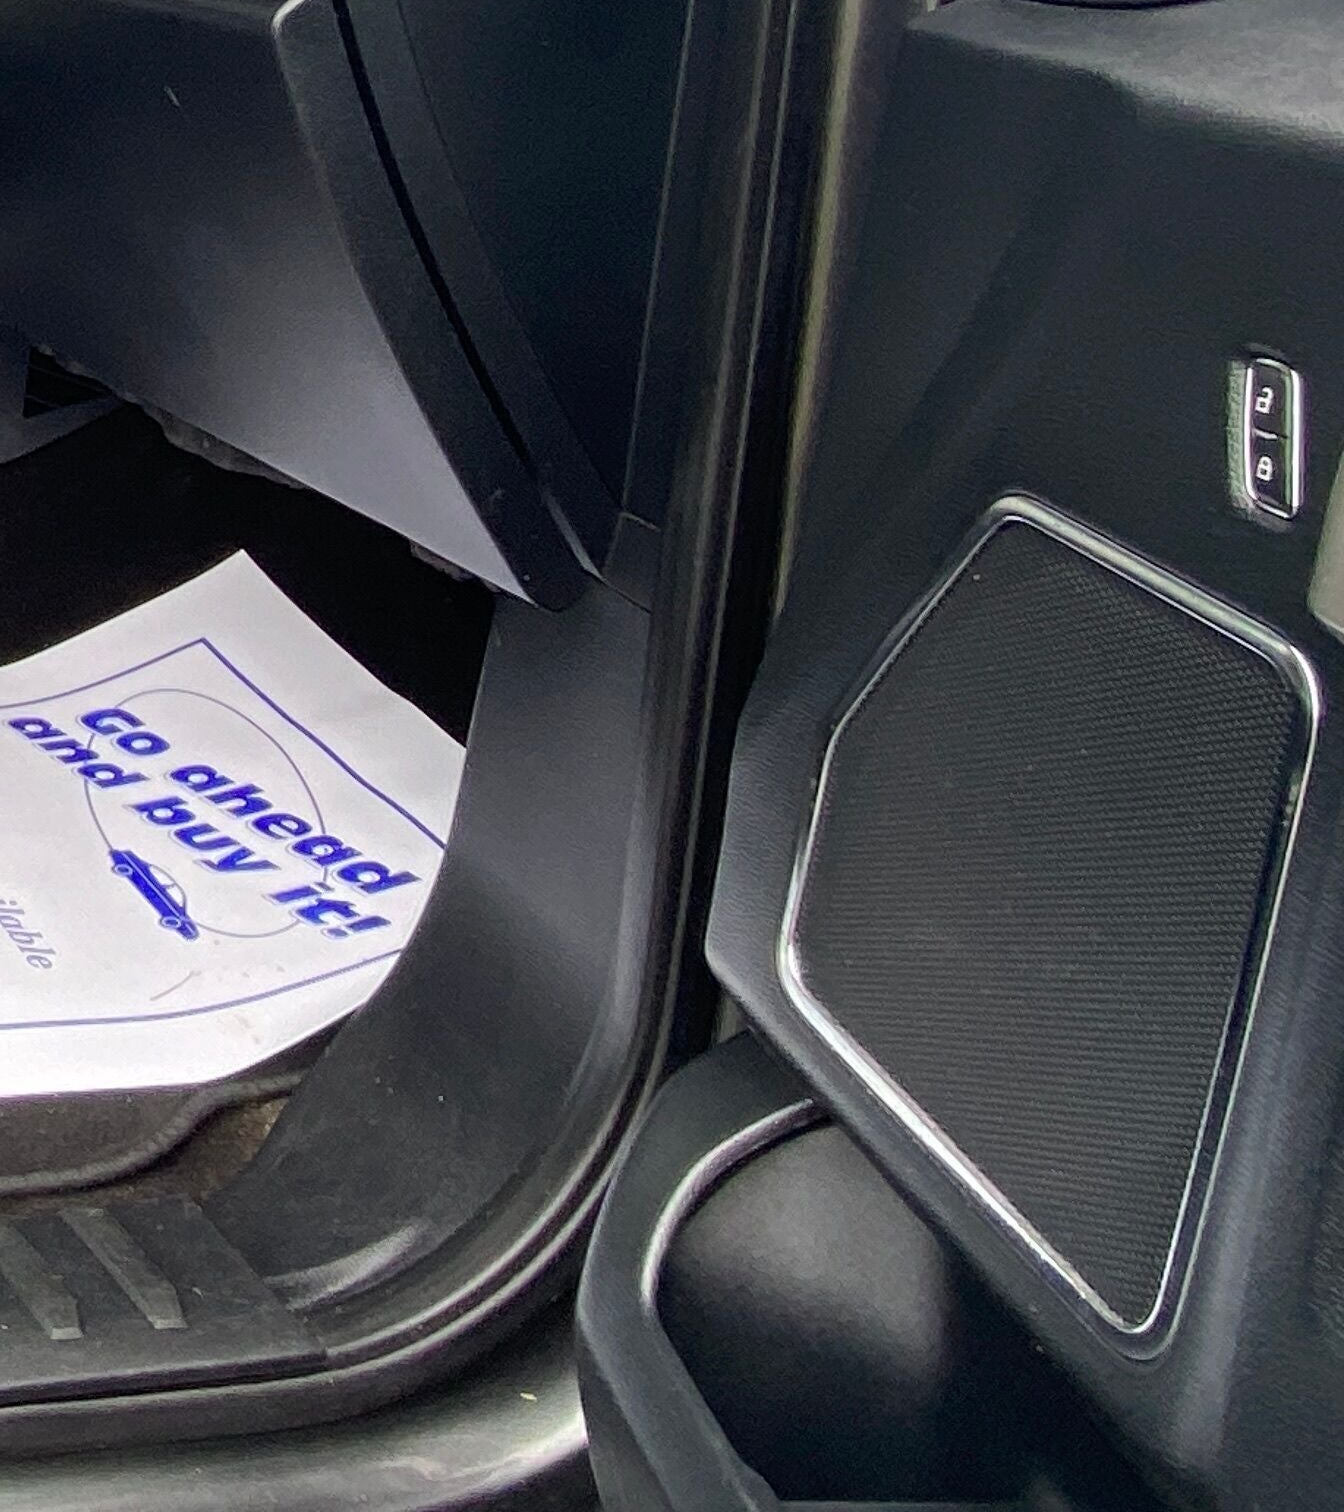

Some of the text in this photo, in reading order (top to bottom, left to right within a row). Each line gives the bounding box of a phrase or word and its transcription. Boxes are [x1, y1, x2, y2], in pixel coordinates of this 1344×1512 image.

[6, 717, 393, 940] and buy it!
[79, 708, 421, 894] Go ahead
